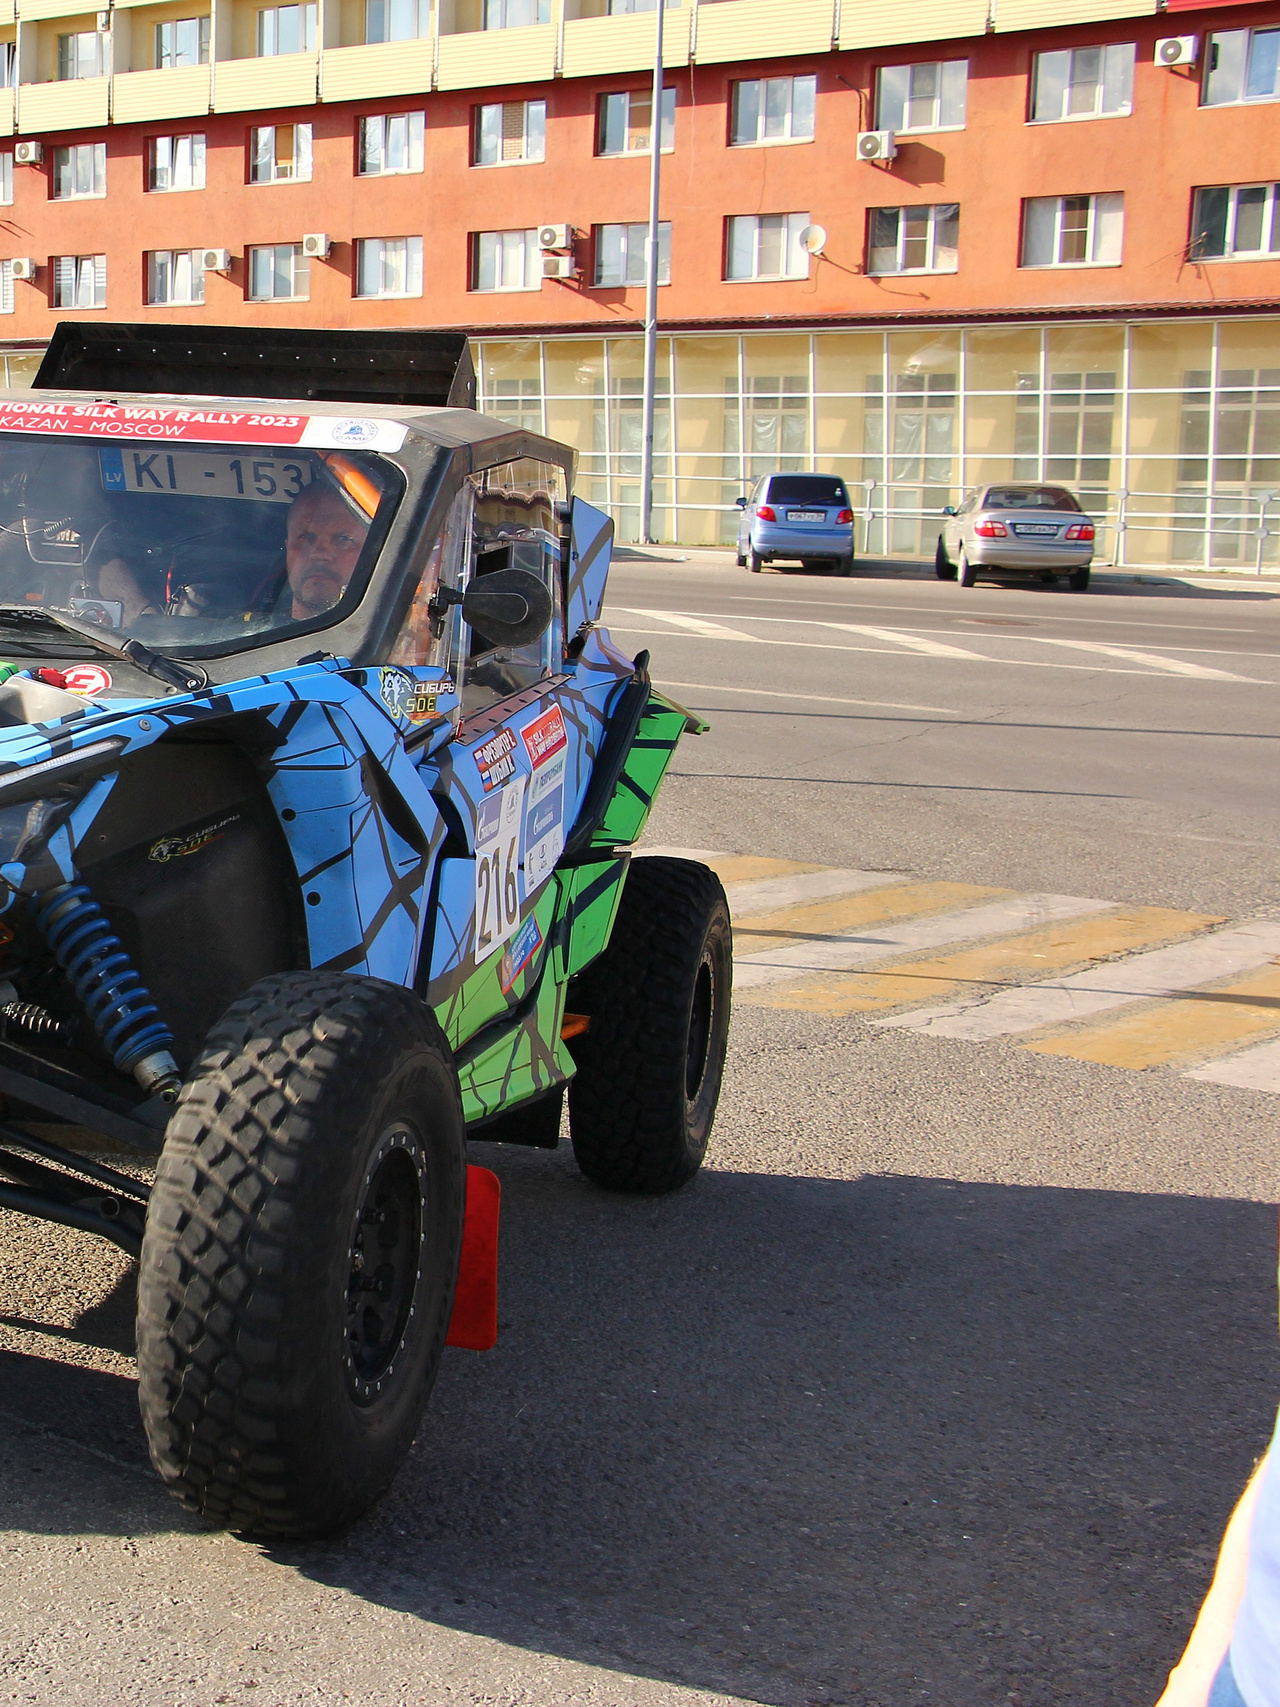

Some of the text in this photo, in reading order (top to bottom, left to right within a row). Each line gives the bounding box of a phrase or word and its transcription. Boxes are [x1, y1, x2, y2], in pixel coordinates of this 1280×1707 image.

[71, 405, 119, 419] SILK
[123, 409, 173, 422] WAY
[175, 411, 246, 425] RALLY
[246, 415, 300, 428] 2023
[89, 420, 187, 436] MOSCOW
[106, 471, 122, 483] LV
[132, 452, 178, 490] KI
[405, 697, 436, 713] SDE
[477, 835, 518, 952] 216
